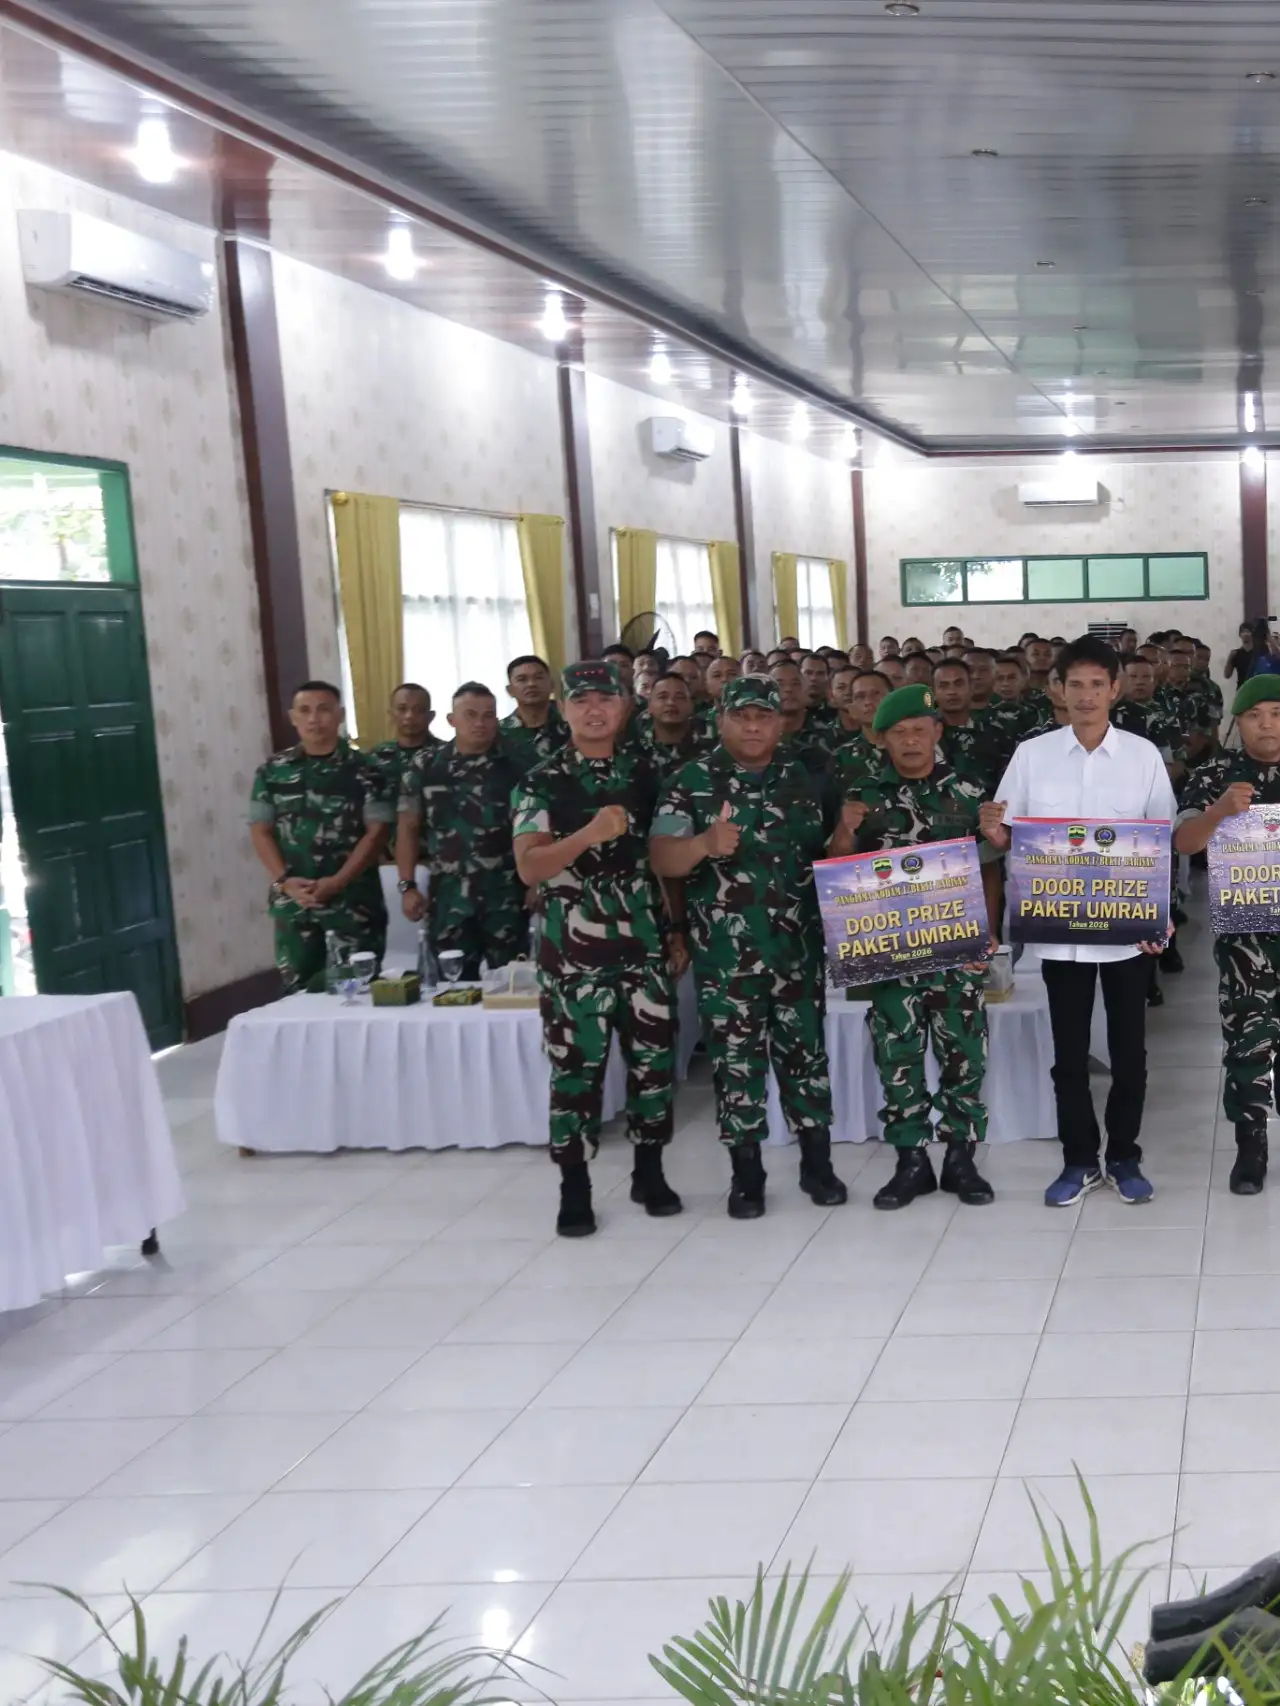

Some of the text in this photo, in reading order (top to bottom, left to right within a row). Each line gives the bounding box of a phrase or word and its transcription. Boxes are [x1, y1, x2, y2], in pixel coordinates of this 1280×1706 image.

[1032, 878, 1148, 897] DOOR PRIZE
[1220, 887, 1280, 906] PAKET
[845, 900, 966, 936] DOOR PRIZE
[1020, 900, 1158, 920] PAKET UMRAH
[1088, 921, 1109, 929] 2026
[838, 920, 980, 960] PAKET UMRAH
